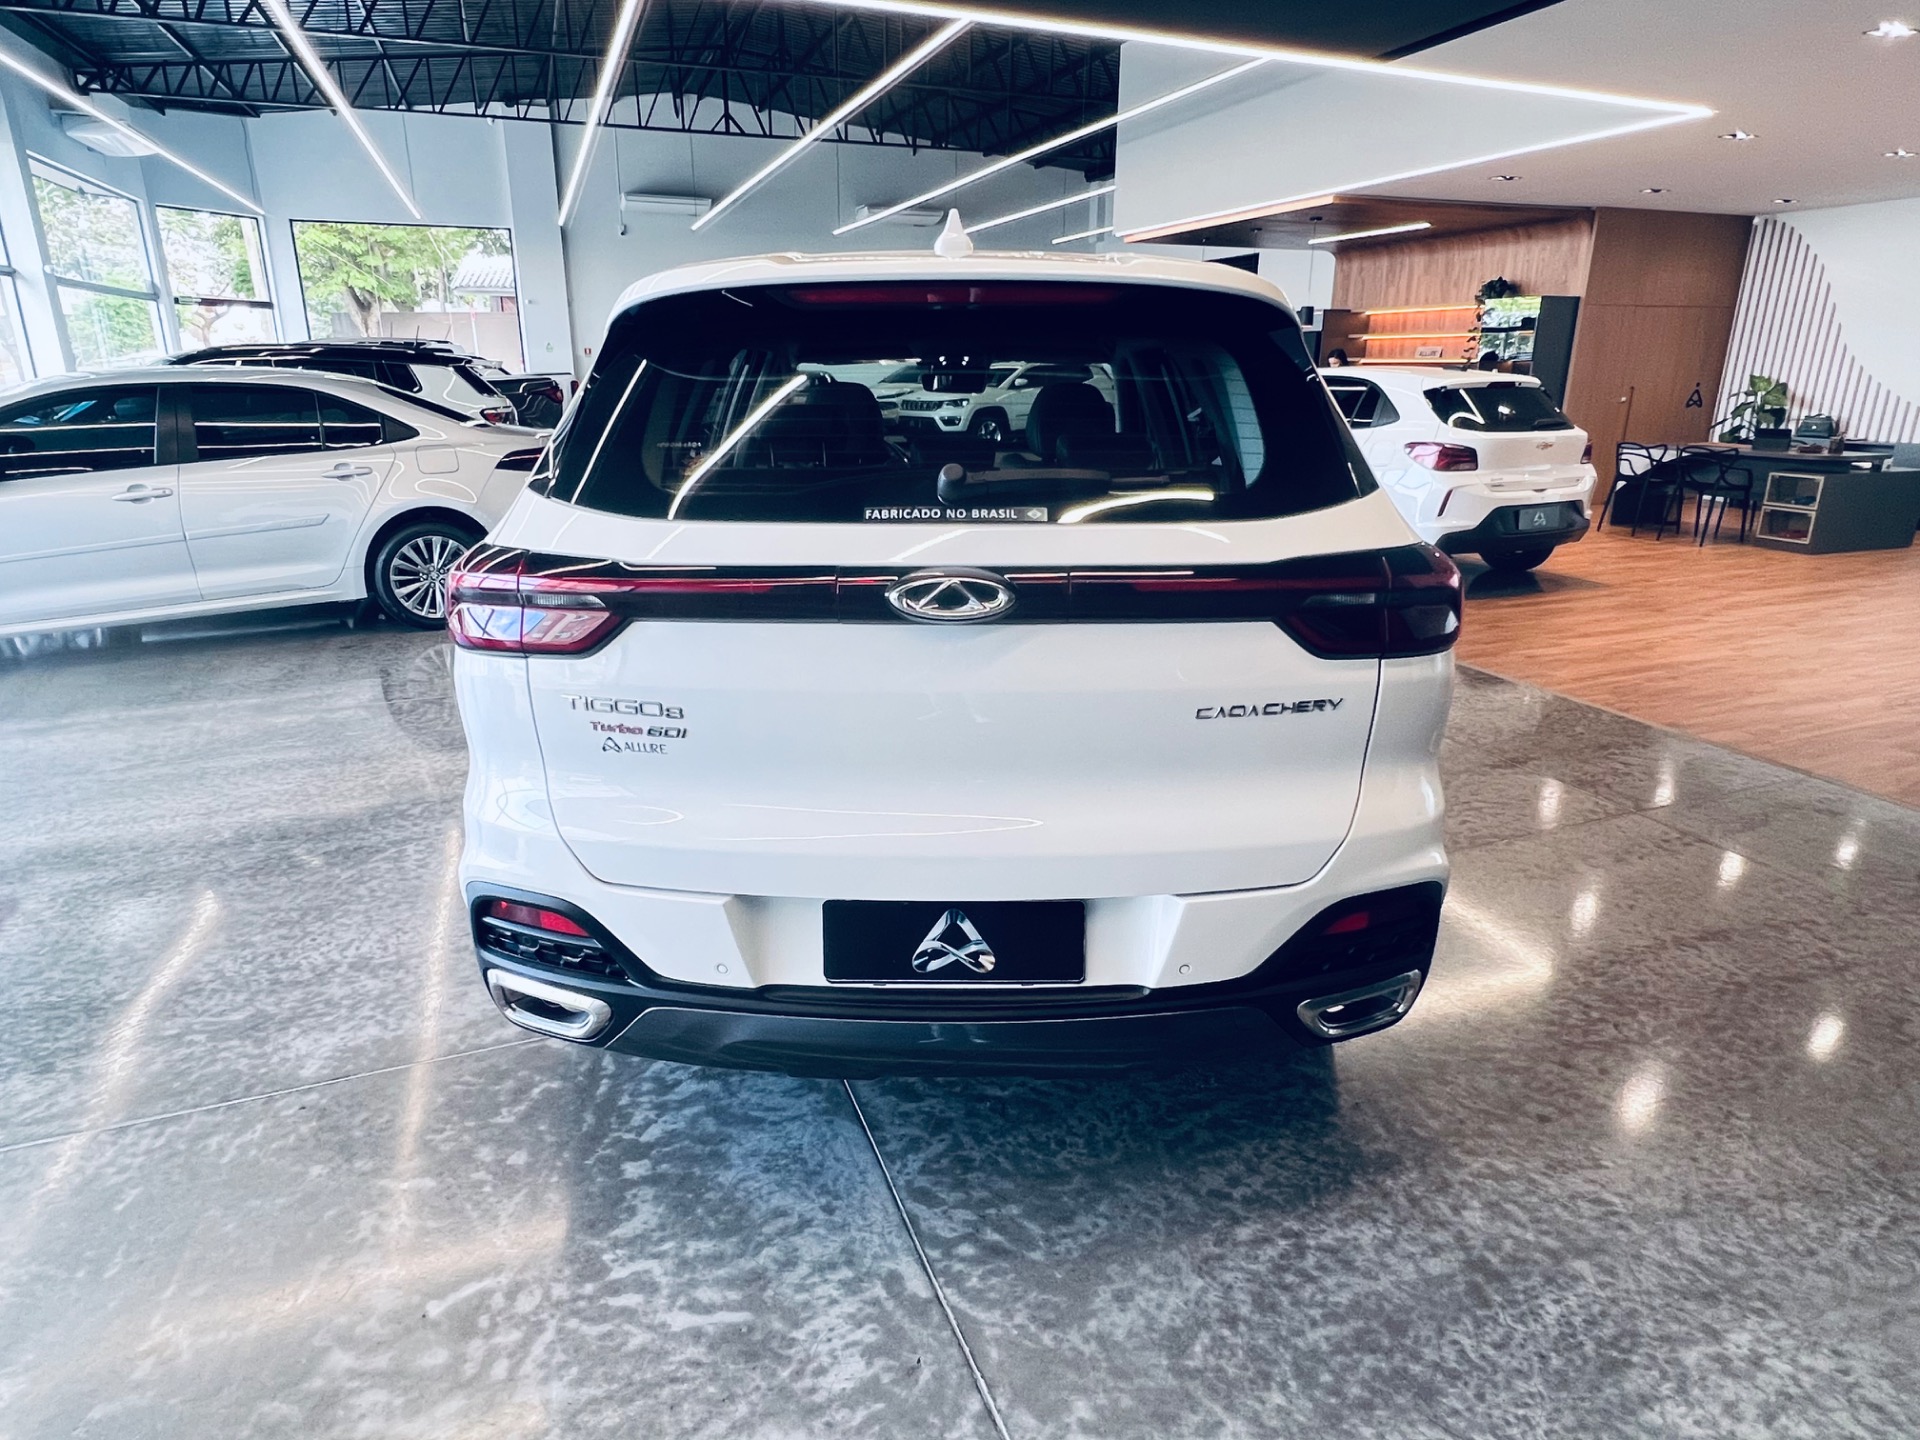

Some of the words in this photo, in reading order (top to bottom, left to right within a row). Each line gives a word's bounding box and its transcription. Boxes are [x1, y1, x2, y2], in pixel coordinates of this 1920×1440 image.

[865, 509, 941, 520] FABRICADO
[946, 508, 967, 519] NO
[971, 508, 1018, 519] BRASIL
[589, 720, 643, 735] Turbo
[624, 741, 668, 754] ALLURE
